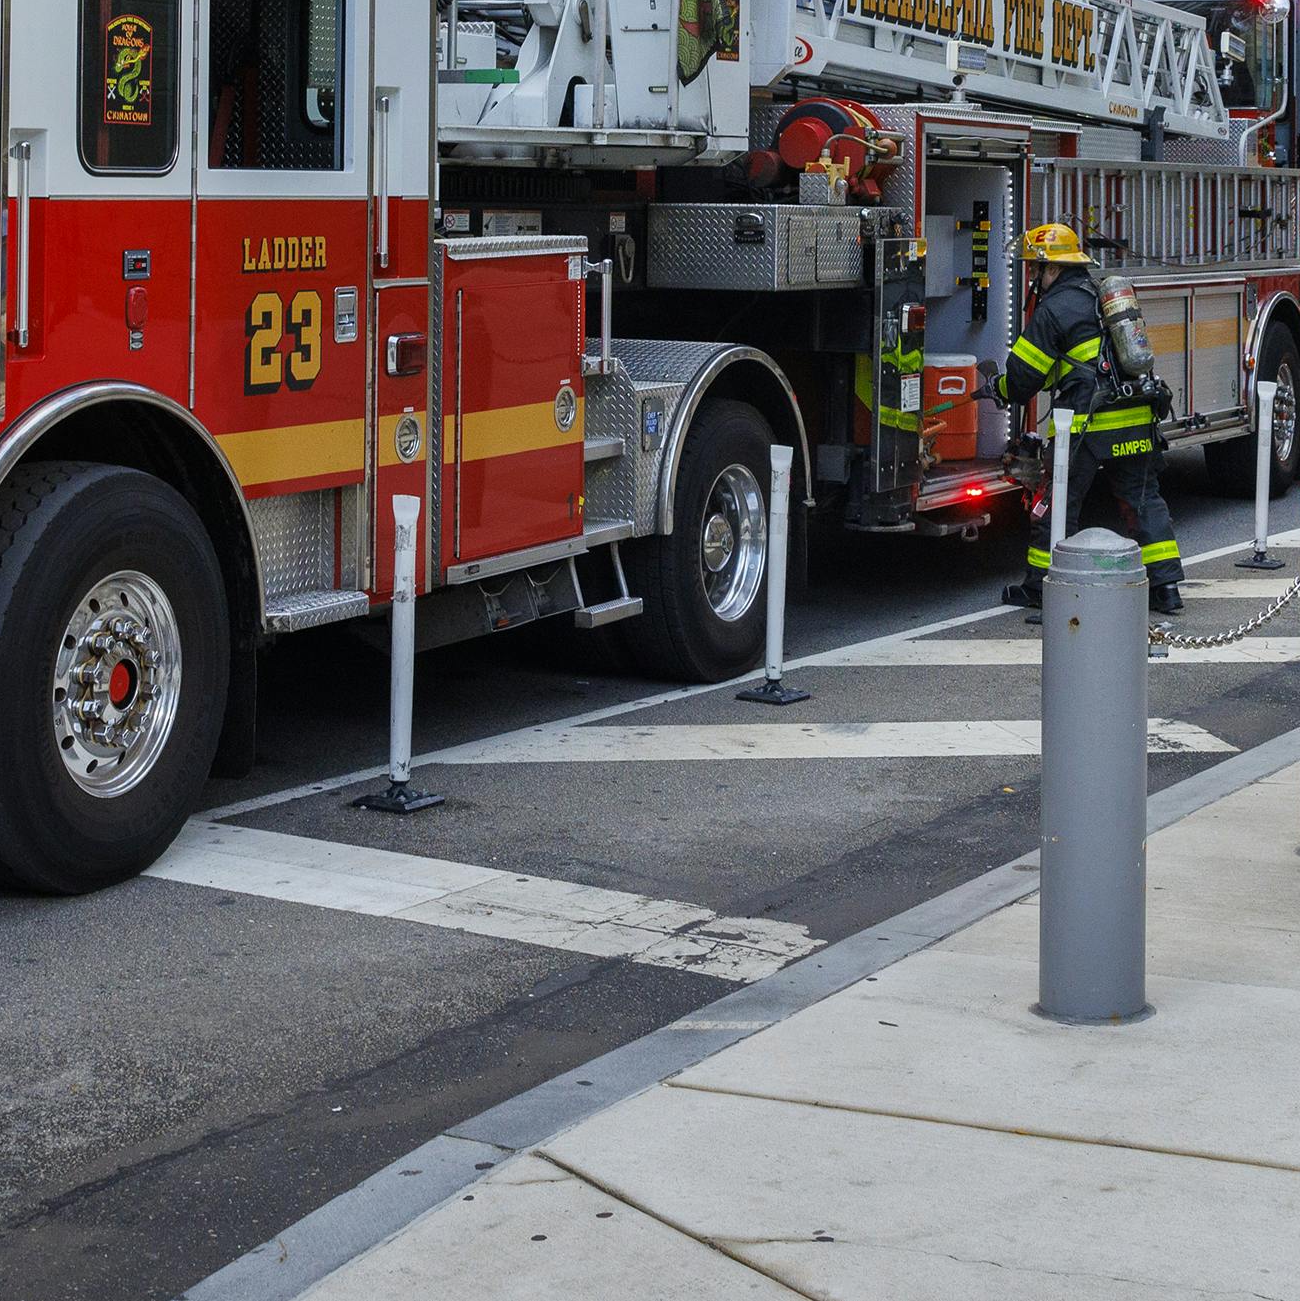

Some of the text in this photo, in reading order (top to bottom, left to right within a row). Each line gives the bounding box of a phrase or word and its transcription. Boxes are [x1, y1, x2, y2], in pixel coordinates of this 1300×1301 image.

[107, 110, 148, 121] CHINATOWN
[1035, 228, 1057, 243] 23
[243, 236, 327, 273] LADDER
[244, 290, 322, 396] 23
